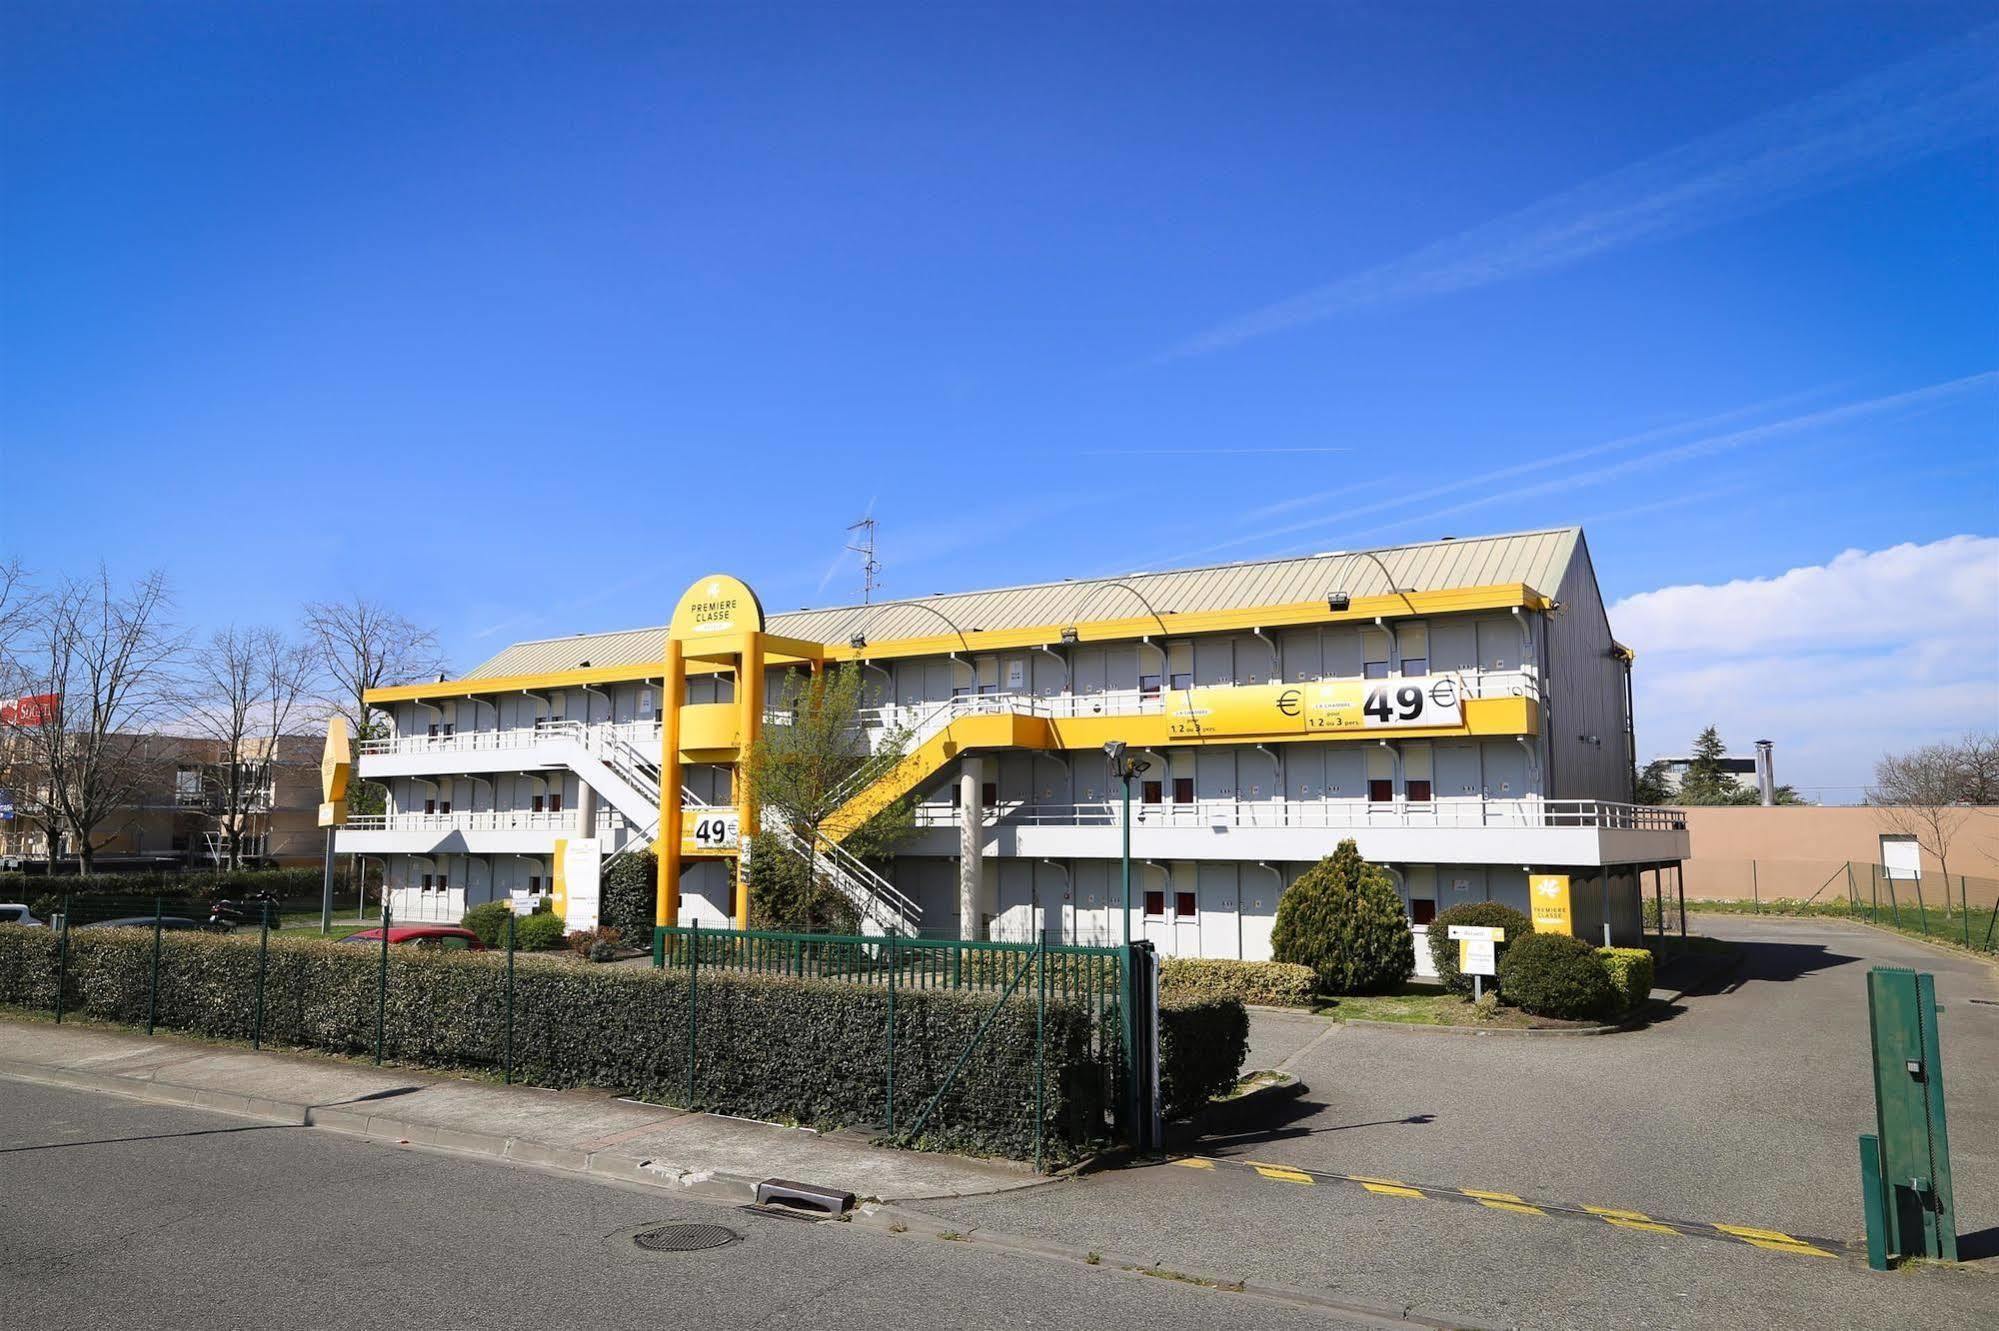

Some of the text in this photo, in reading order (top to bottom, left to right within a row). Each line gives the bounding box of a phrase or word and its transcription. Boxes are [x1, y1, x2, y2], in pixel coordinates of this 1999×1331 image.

[691, 600, 736, 613] PREMIERE
[696, 611, 729, 622] CLASSE
[1318, 718, 1324, 726] 2
[1337, 717, 1342, 726] 3
